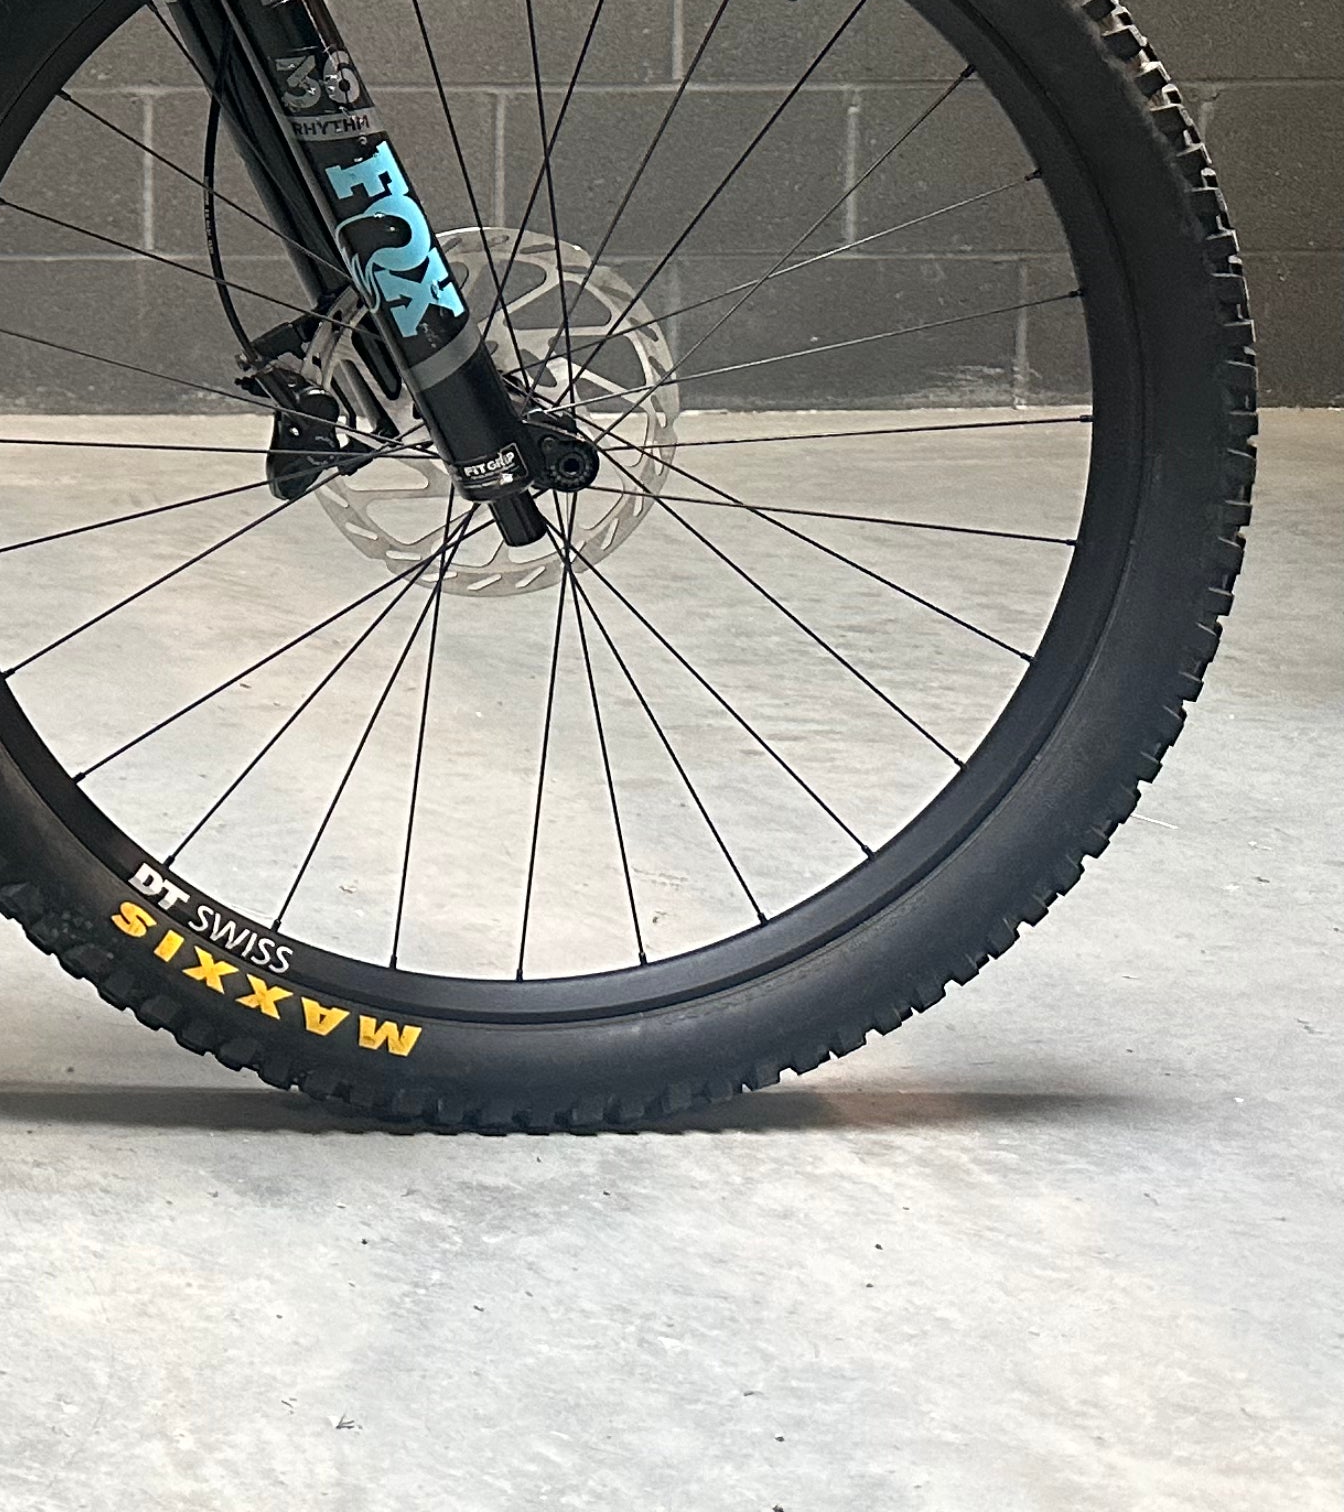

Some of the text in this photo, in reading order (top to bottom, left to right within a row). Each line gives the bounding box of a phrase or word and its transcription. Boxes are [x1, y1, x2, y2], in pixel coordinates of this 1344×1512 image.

[292, 113, 371, 137] RHYTHM
[324, 140, 466, 338] FOX
[111, 900, 423, 1058] MAXXIS
[128, 862, 295, 975] DT SWISS
